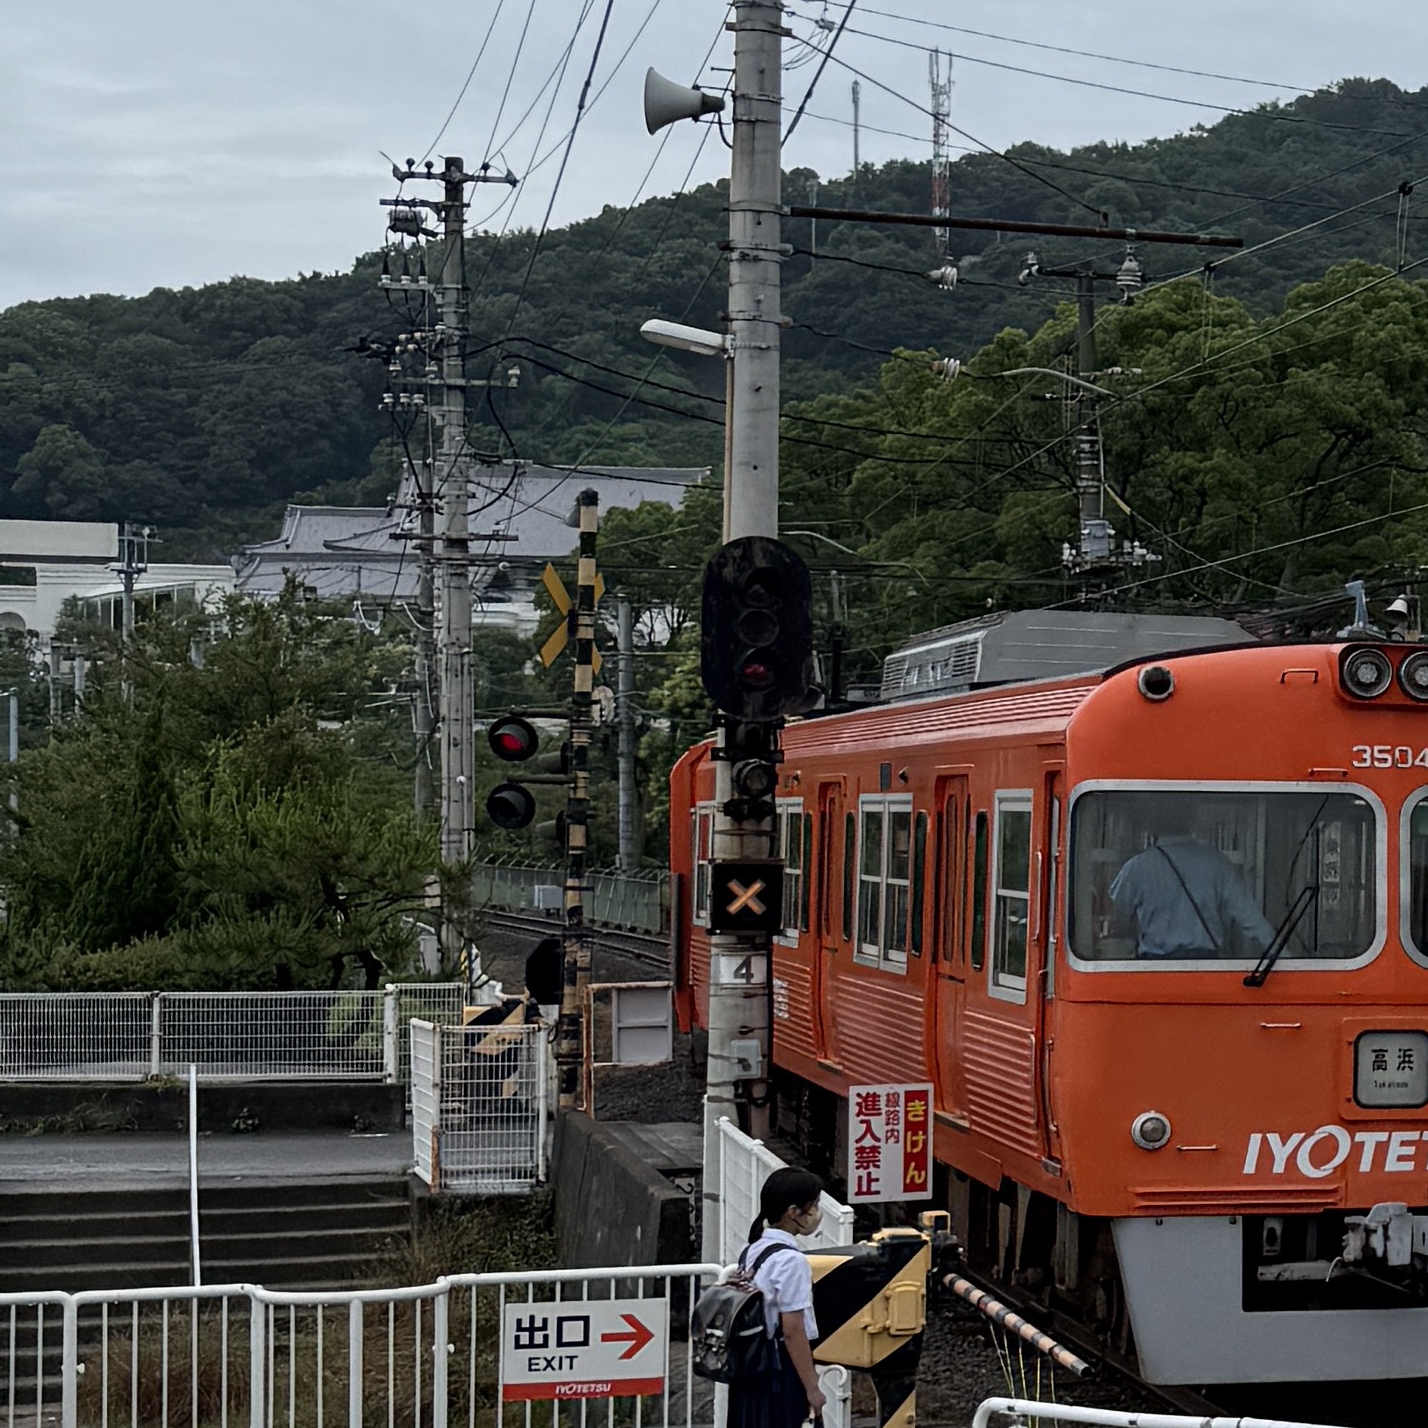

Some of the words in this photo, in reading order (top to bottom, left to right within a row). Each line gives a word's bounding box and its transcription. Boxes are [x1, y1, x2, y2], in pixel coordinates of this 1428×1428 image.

[733, 955, 754, 984] 4
[1371, 1048, 1414, 1072] 高浜
[885, 1091, 901, 1144] 線路内
[854, 1092, 882, 1196] 進入禁止
[906, 1100, 927, 1184] きけん
[514, 1314, 591, 1349] 出口
[528, 1355, 579, 1372] EXIT
[555, 1383, 612, 1395] IYOTETSU
